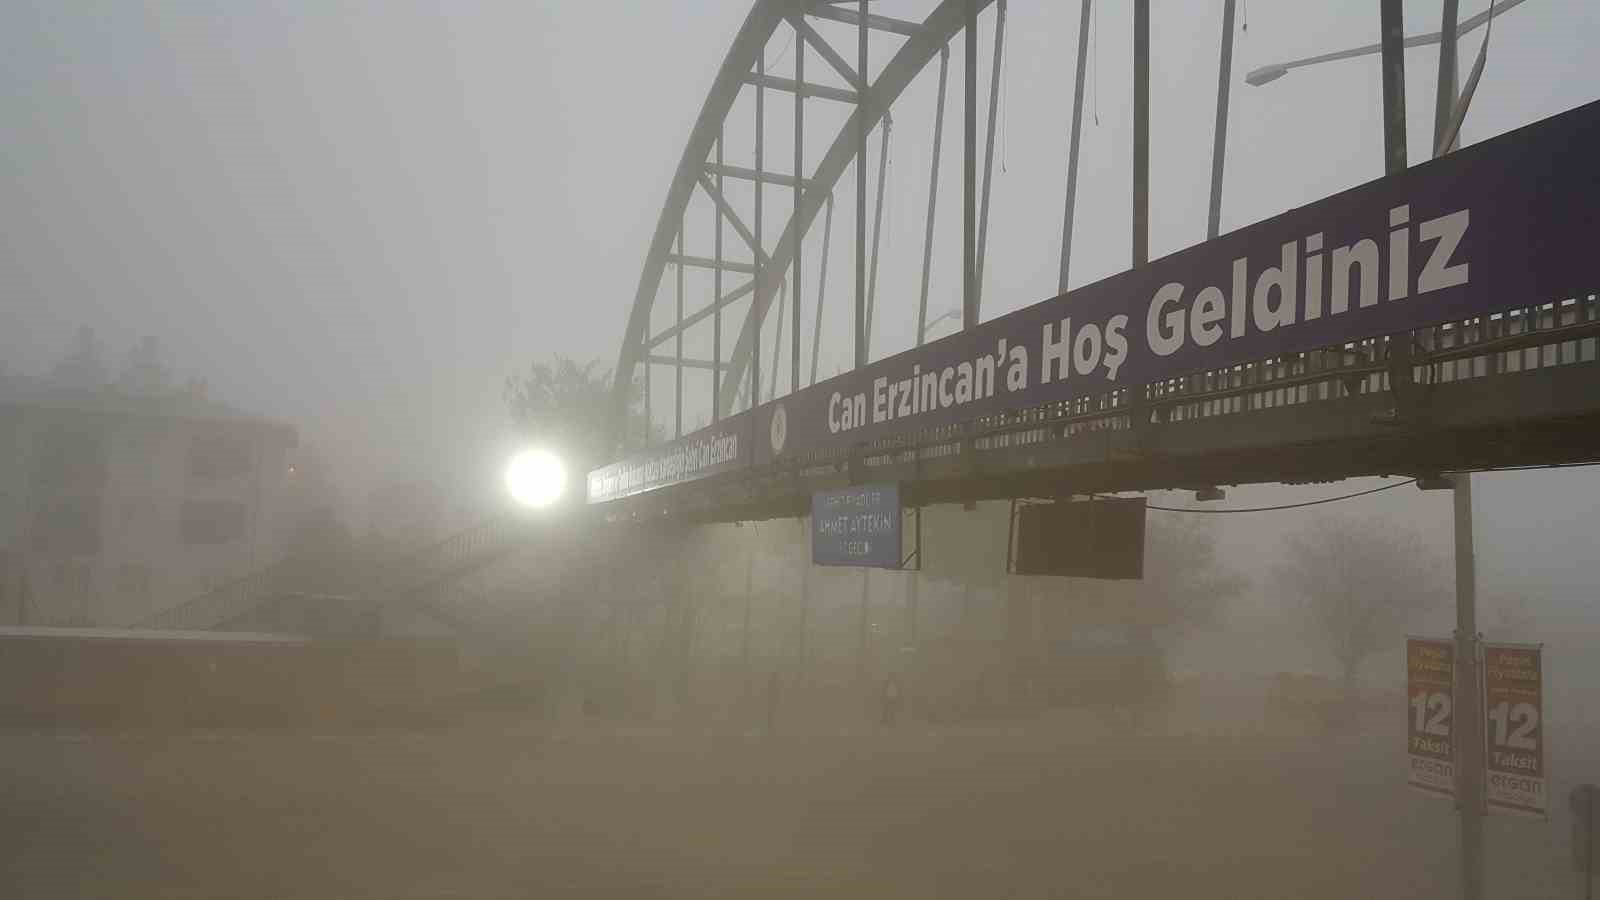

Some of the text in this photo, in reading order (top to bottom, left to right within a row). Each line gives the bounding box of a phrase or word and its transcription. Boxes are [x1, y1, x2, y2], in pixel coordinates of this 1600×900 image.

[828, 204, 1470, 434] Can Erzincan'a Hoş Geldiniz
[1411, 691, 1451, 735] 12
[1488, 701, 1539, 751] 12
[1412, 736, 1451, 756] Taksit
[1493, 751, 1538, 771] Taksit
